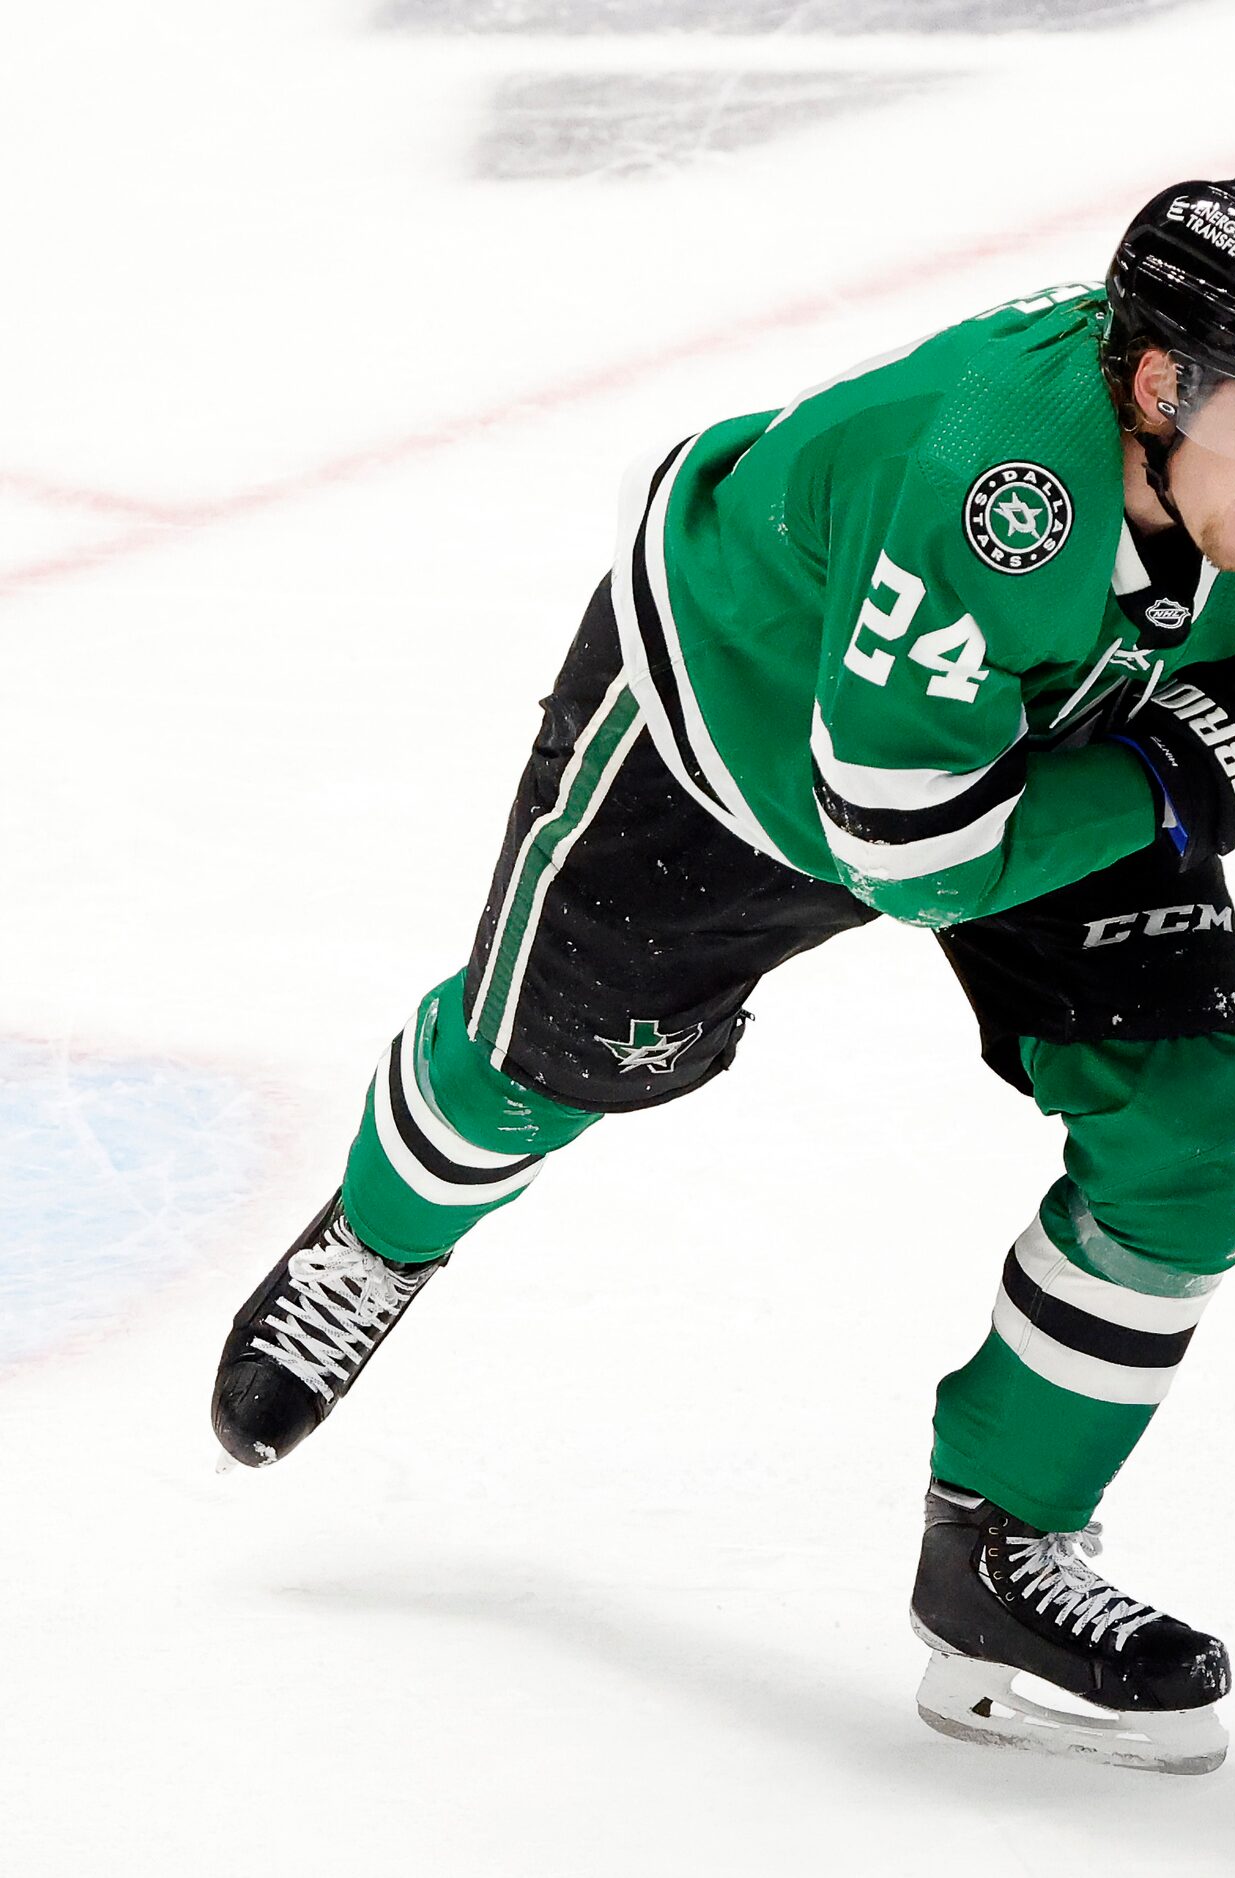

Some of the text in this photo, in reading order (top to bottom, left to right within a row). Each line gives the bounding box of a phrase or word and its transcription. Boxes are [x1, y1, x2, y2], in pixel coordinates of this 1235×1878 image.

[973, 470, 1063, 567] DALLAS STARS
[843, 548, 989, 704] 24
[1082, 903, 1233, 949] CCM
